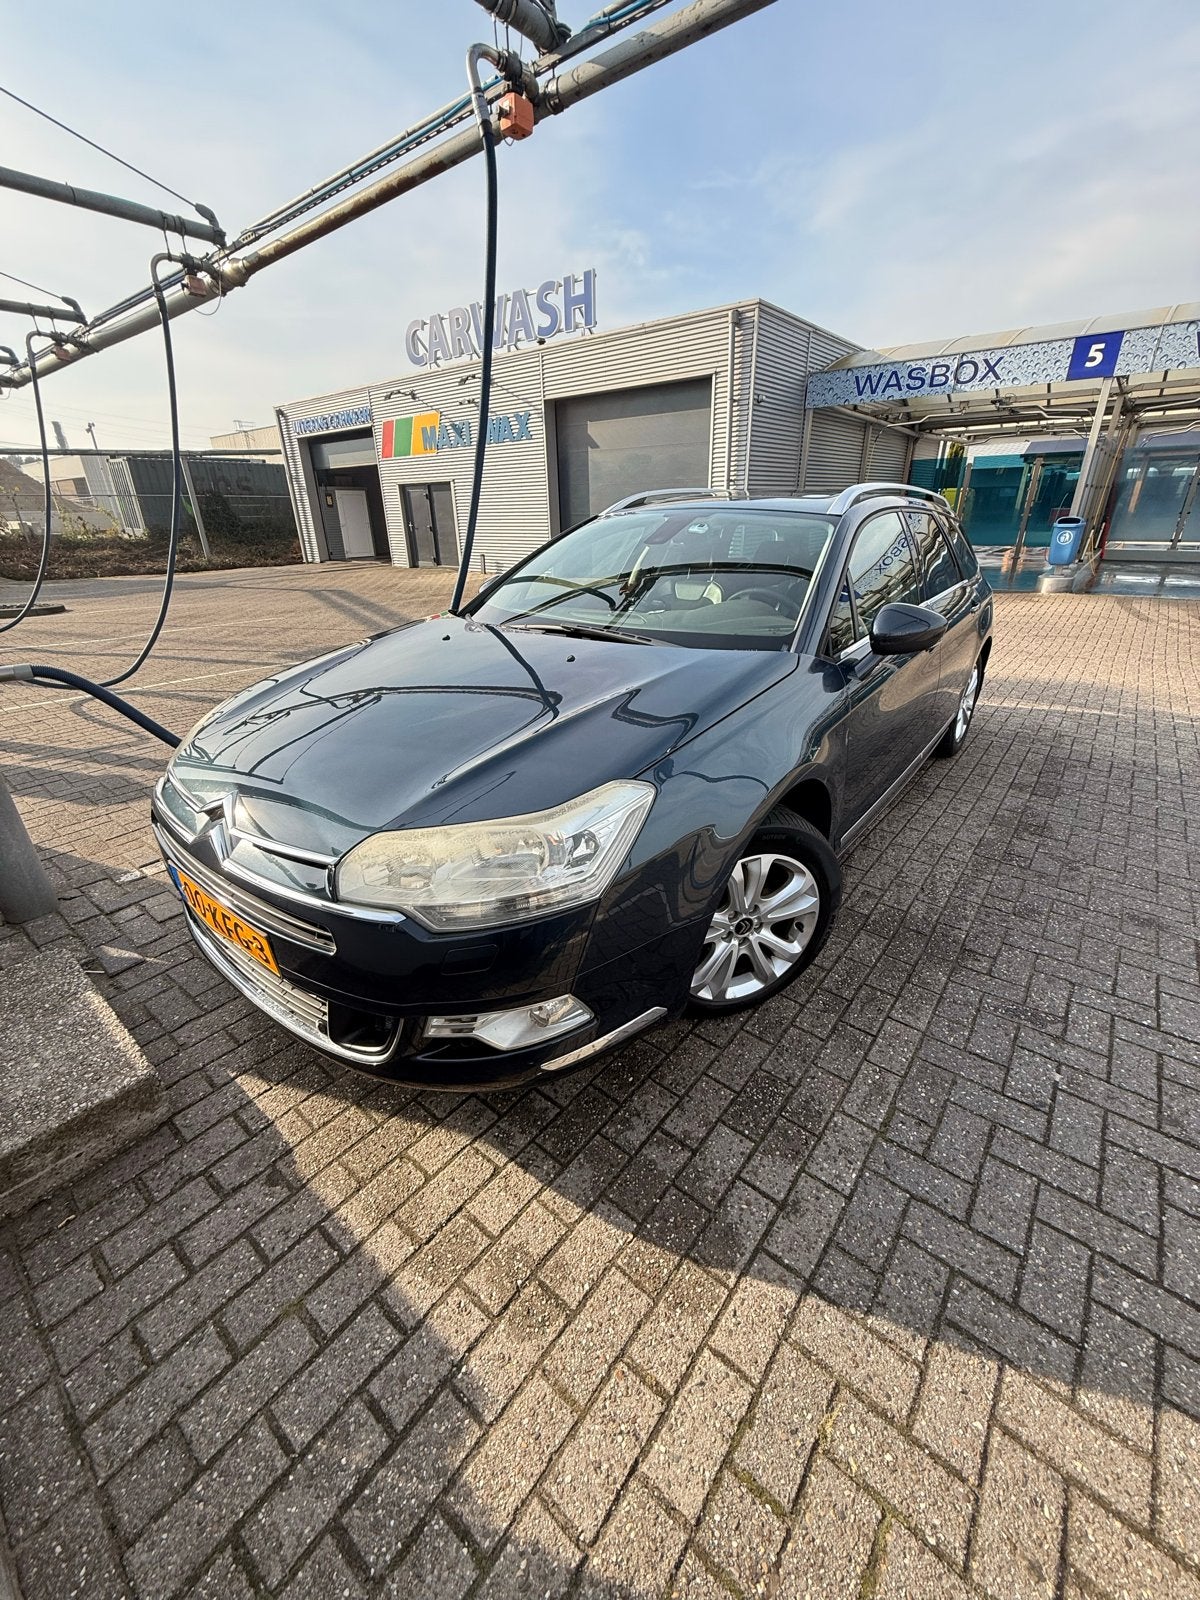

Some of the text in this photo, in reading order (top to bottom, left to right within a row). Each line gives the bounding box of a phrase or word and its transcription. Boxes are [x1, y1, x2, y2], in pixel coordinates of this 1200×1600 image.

[405, 268, 597, 367] CARWASH
[1083, 343, 1106, 368] 5
[854, 356, 1004, 397] WASBOX
[292, 406, 372, 434] UITGANG CARWASH
[421, 420, 471, 451] MAXI
